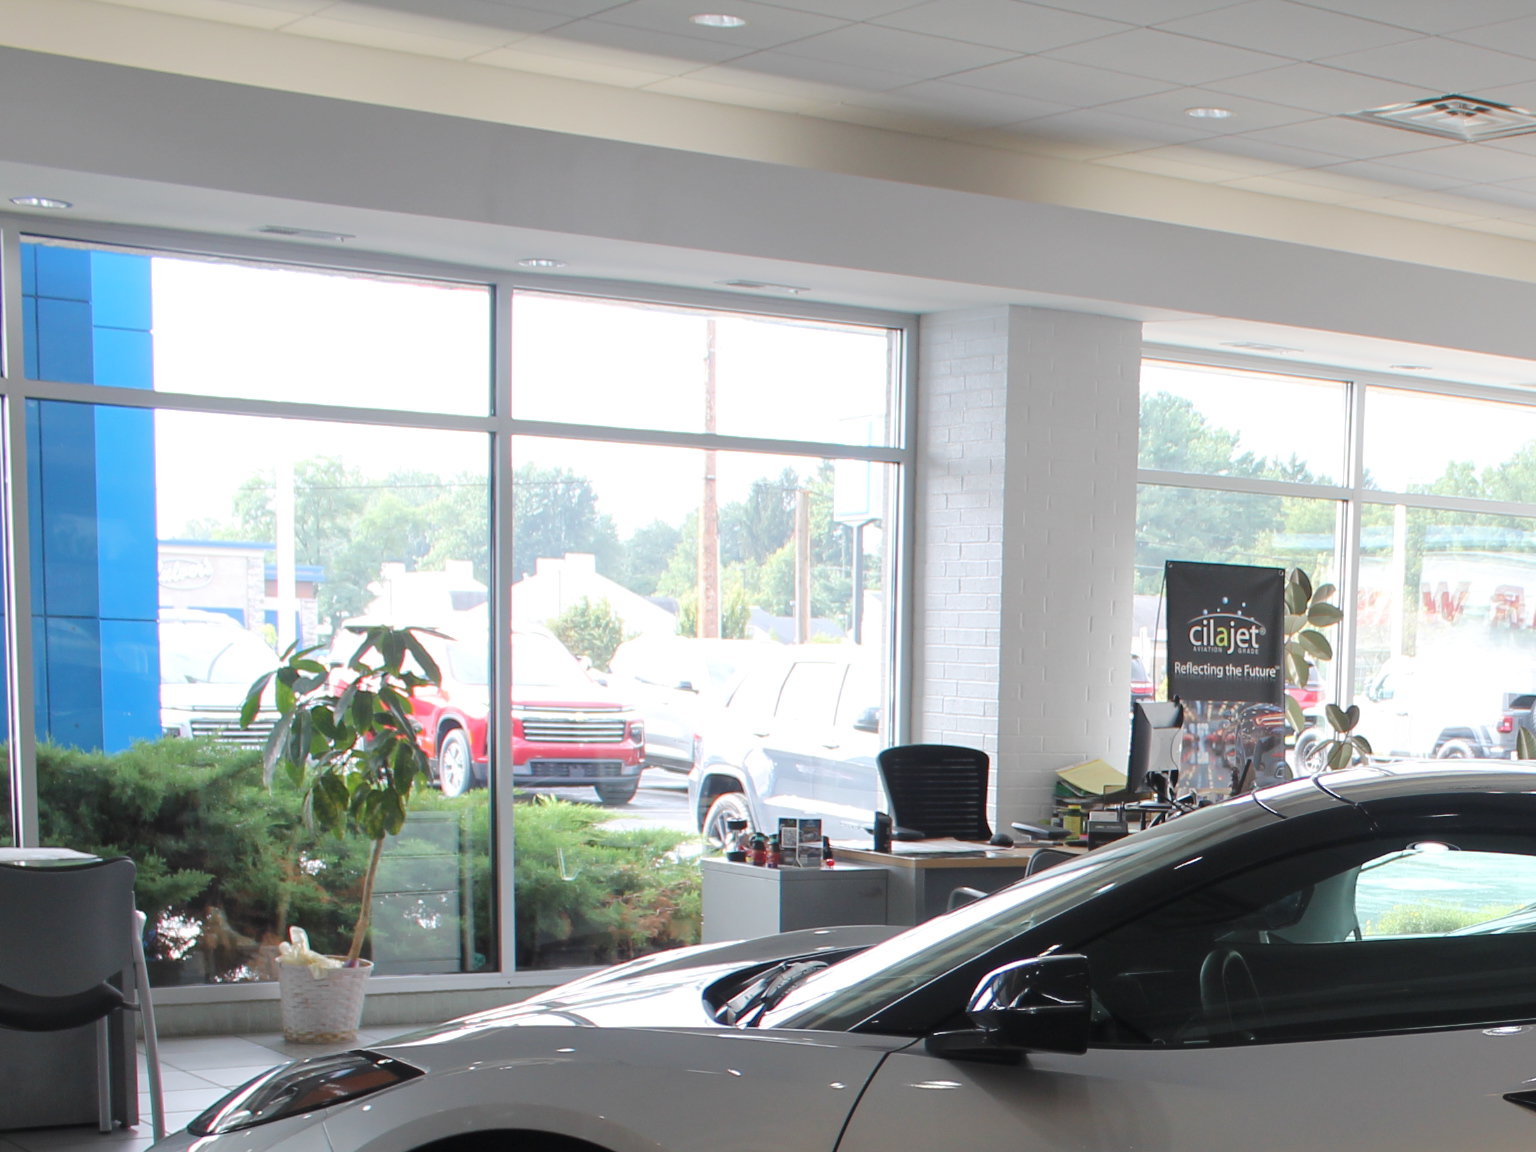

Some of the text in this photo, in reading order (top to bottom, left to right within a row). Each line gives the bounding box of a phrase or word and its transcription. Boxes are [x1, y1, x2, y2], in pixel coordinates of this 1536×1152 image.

[159, 557, 213, 583] ulver's
[1189, 619, 1259, 654] cilajet
[1174, 661, 1277, 678] Reflecting the Future
